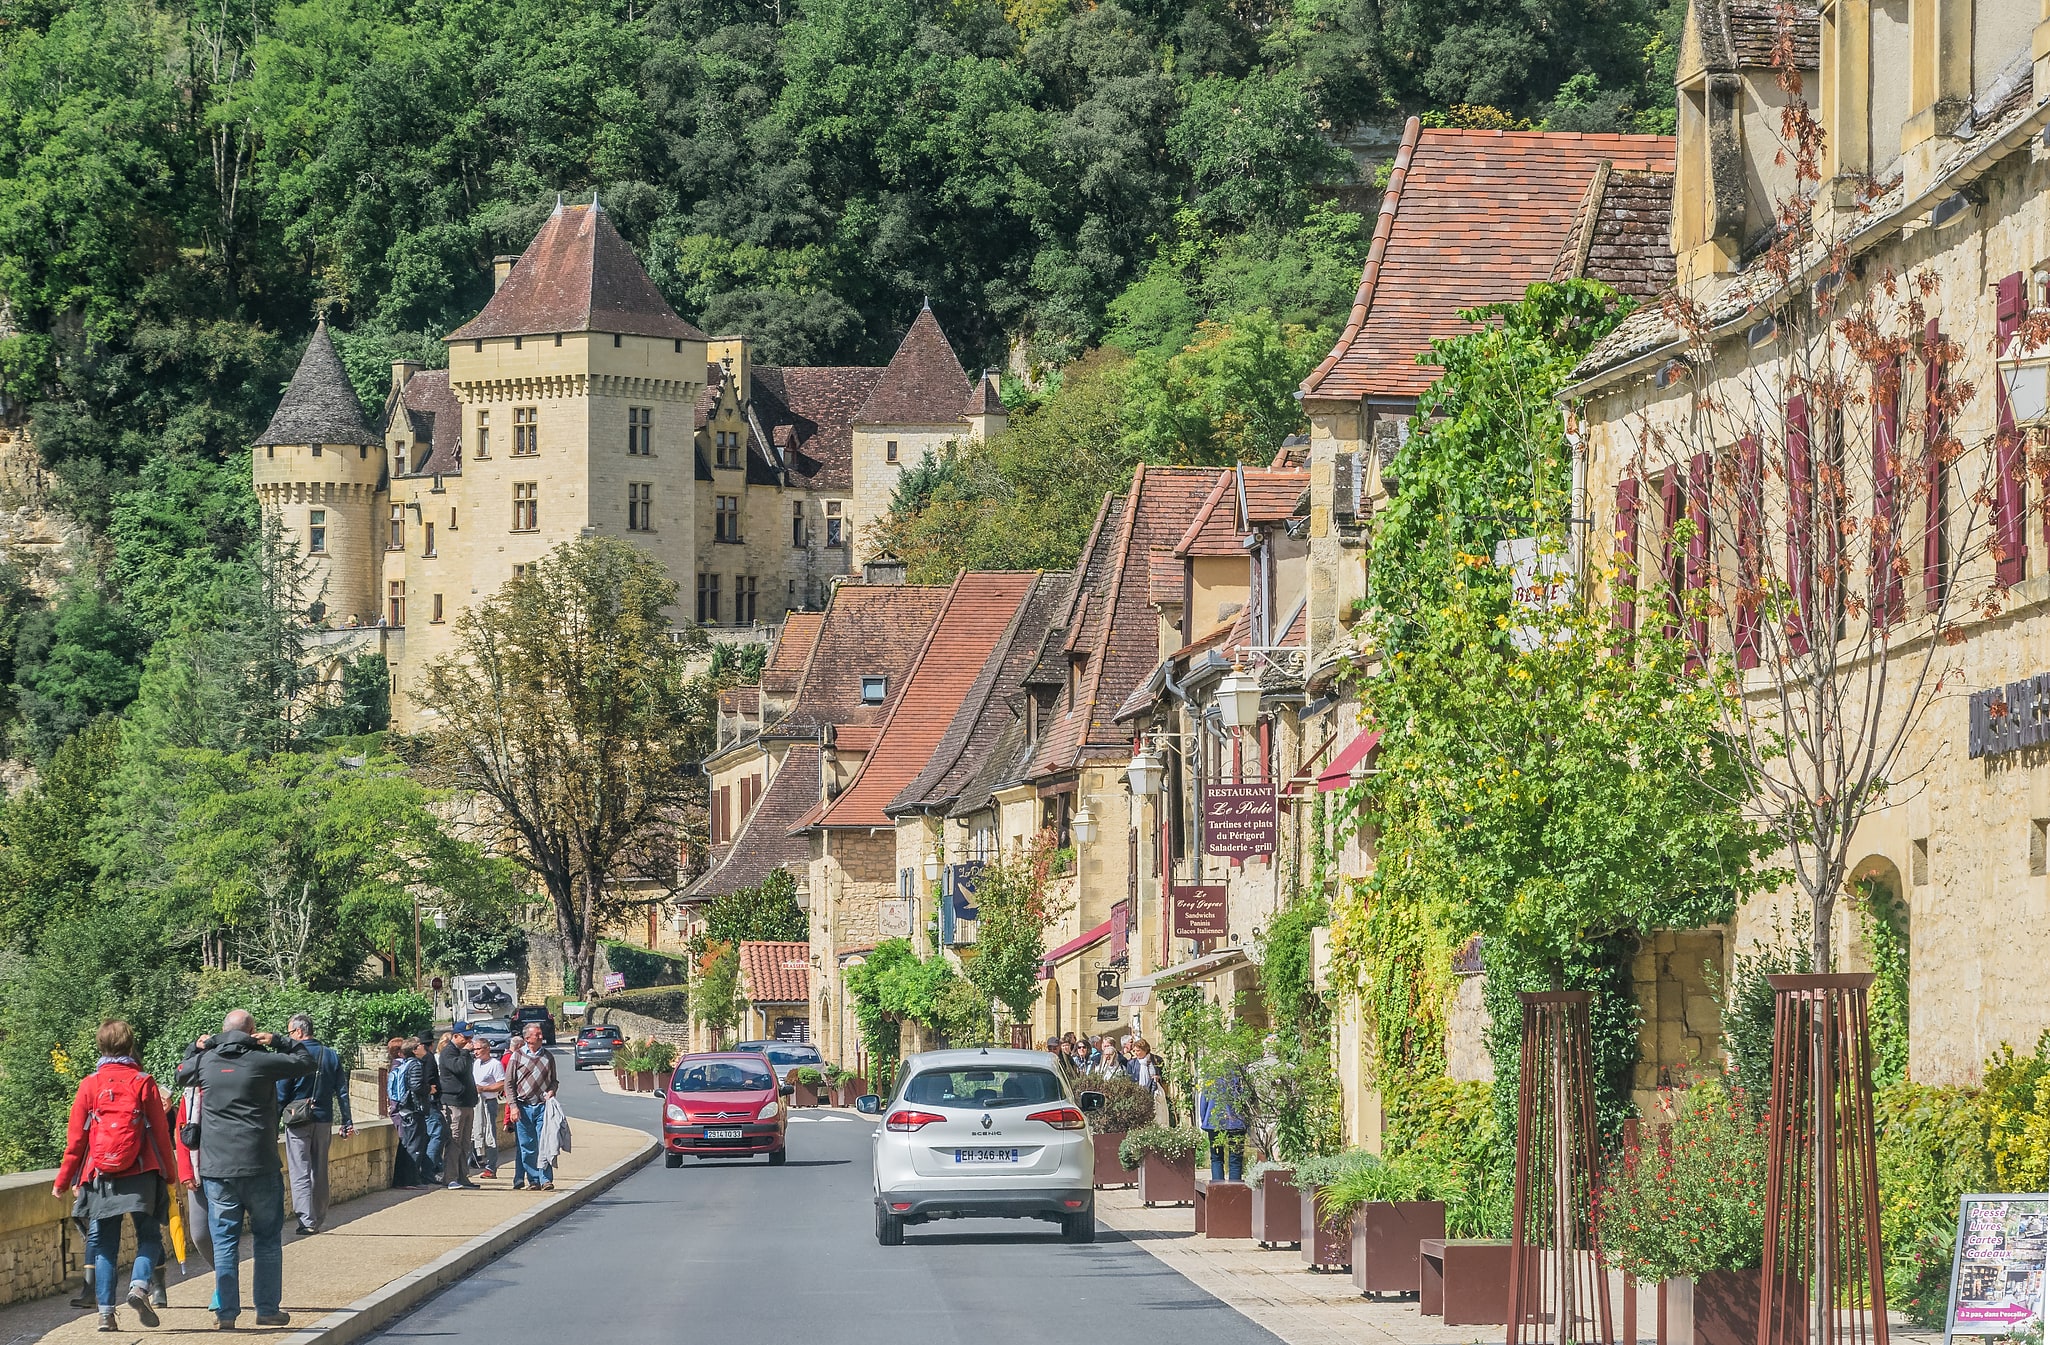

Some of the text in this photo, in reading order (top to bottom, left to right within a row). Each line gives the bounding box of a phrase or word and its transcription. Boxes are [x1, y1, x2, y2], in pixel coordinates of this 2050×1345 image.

[1208, 788, 1273, 797] RESTAURANT
[1208, 801, 1233, 816] Le
[1208, 819, 1273, 830] Tartines et plats
[1216, 831, 1265, 841] du Périgord
[1209, 843, 1248, 852] Saladerie
[1254, 842, 1272, 853] grill
[961, 1150, 1011, 1161] EH-346-RX
[1971, 1208, 2006, 1217] Presse
[1970, 1222, 2002, 1231] Livres
[1968, 1235, 2003, 1245] Cartes
[1966, 1249, 2012, 1258] Cadeaux
